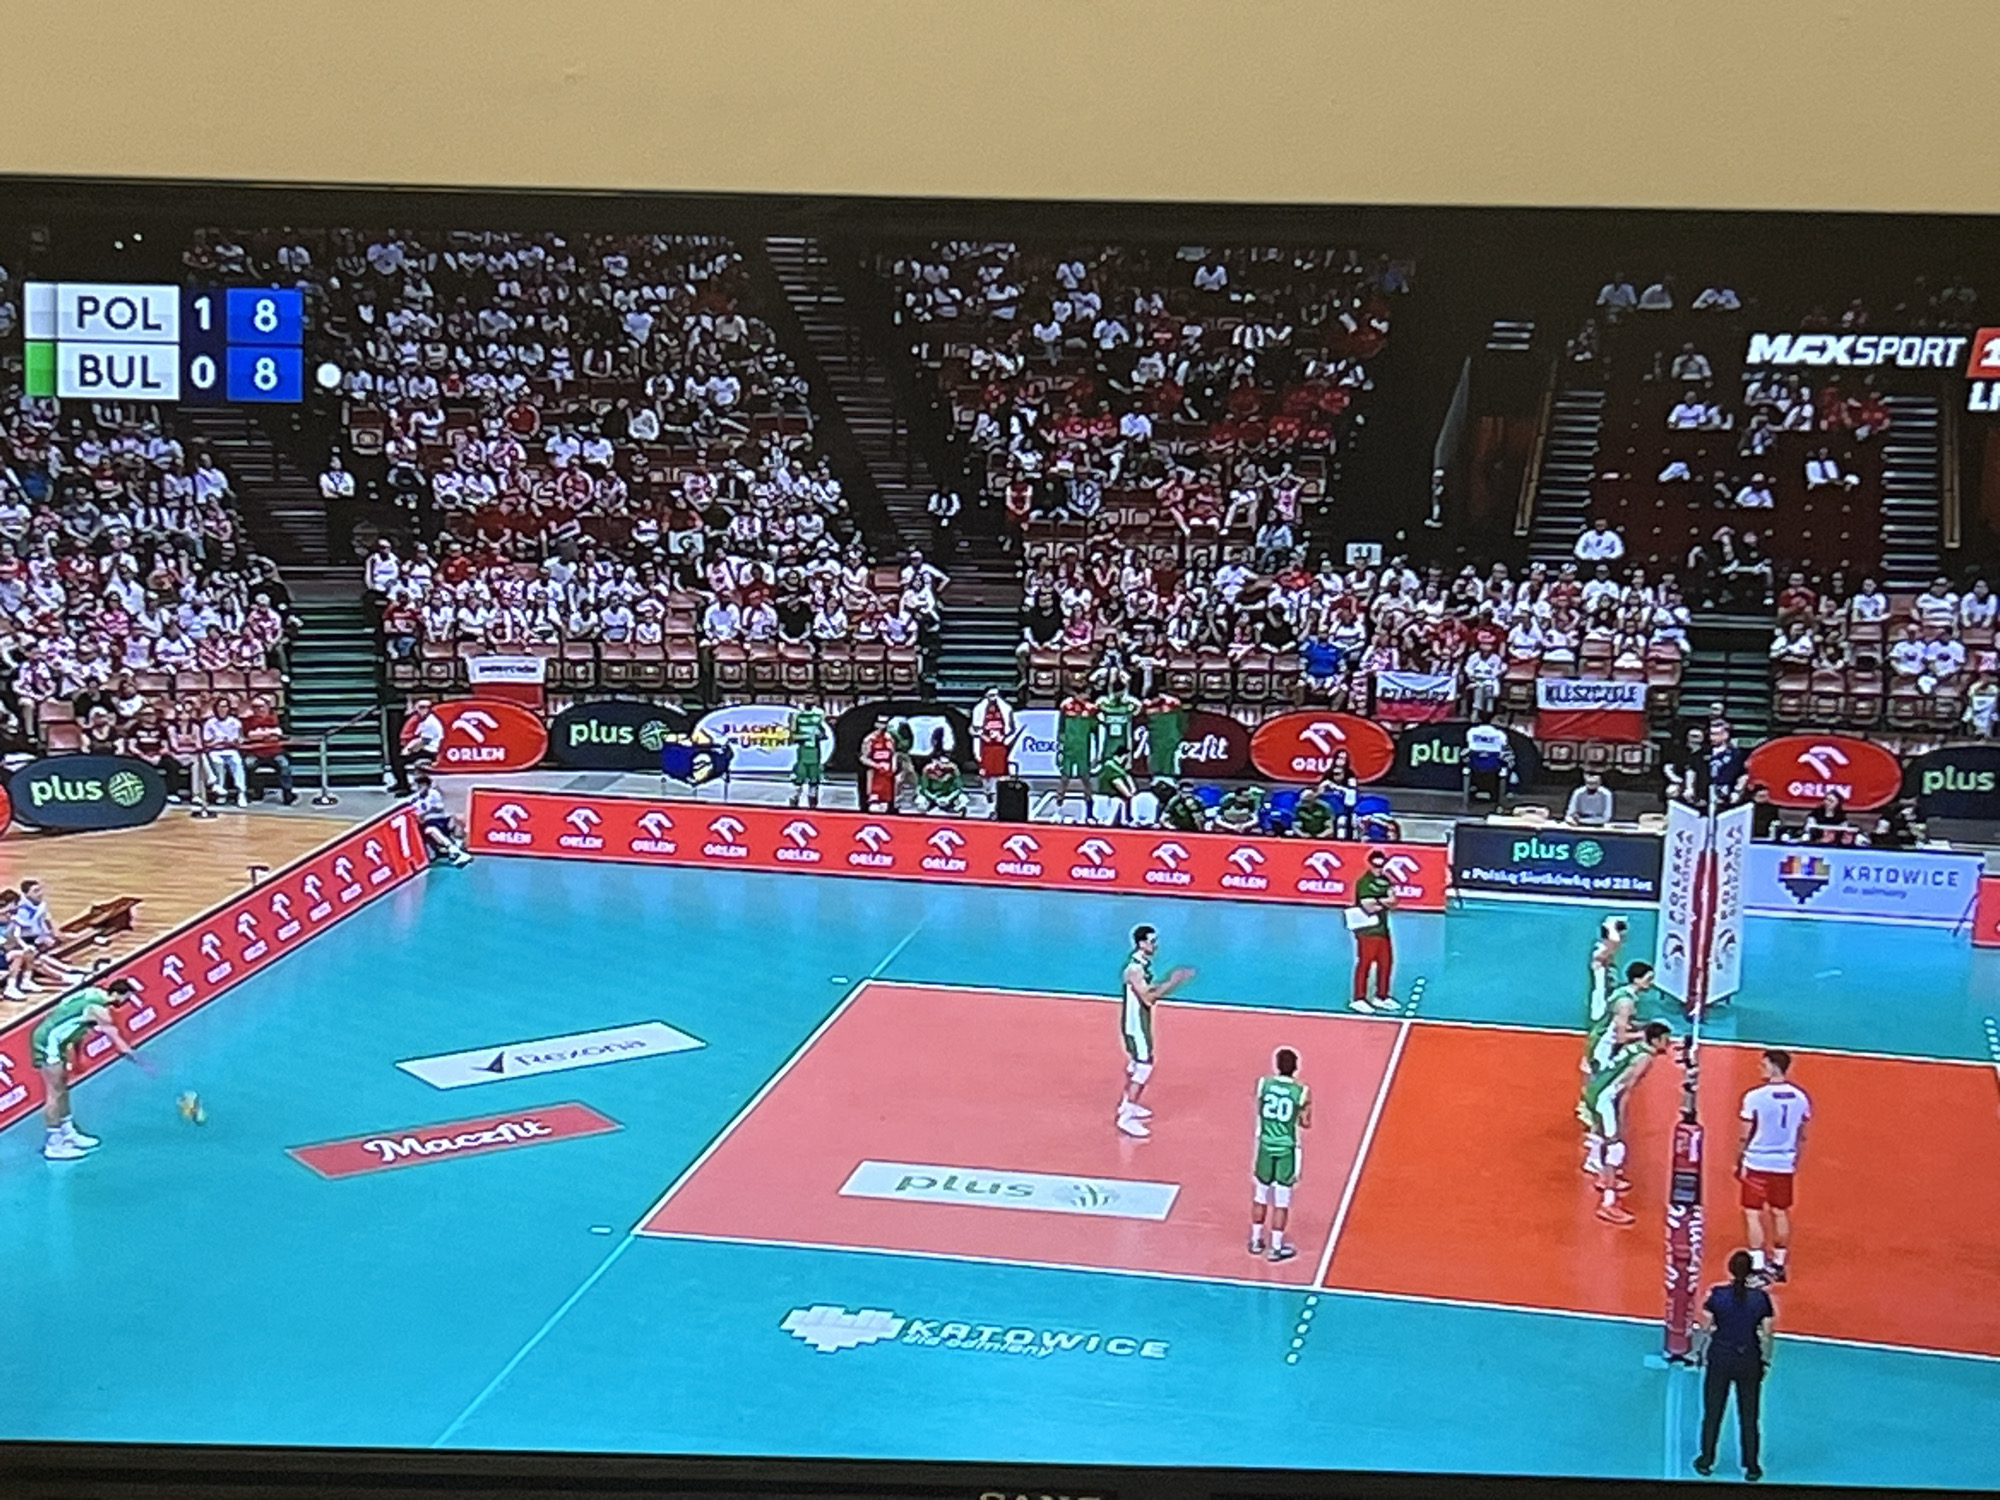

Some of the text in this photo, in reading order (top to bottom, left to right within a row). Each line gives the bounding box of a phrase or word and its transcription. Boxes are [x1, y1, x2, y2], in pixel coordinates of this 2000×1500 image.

[76, 295, 278, 332] POL 1 8
[78, 354, 278, 391] BUL 0 8
[569, 719, 635, 746] plus
[446, 747, 506, 762] ORLEN
[1410, 740, 1460, 766] plu
[30, 775, 104, 806] plus
[1922, 765, 1995, 794] plus
[1513, 838, 1570, 862] plus
[1844, 865, 1959, 888] KATOWICE
[1262, 1093, 1294, 1122] 20
[1780, 1103, 1788, 1129] 1
[364, 1118, 552, 1163] Maczfit
[895, 1173, 1037, 1198] plus
[906, 1319, 1171, 1359] KATOWICE
